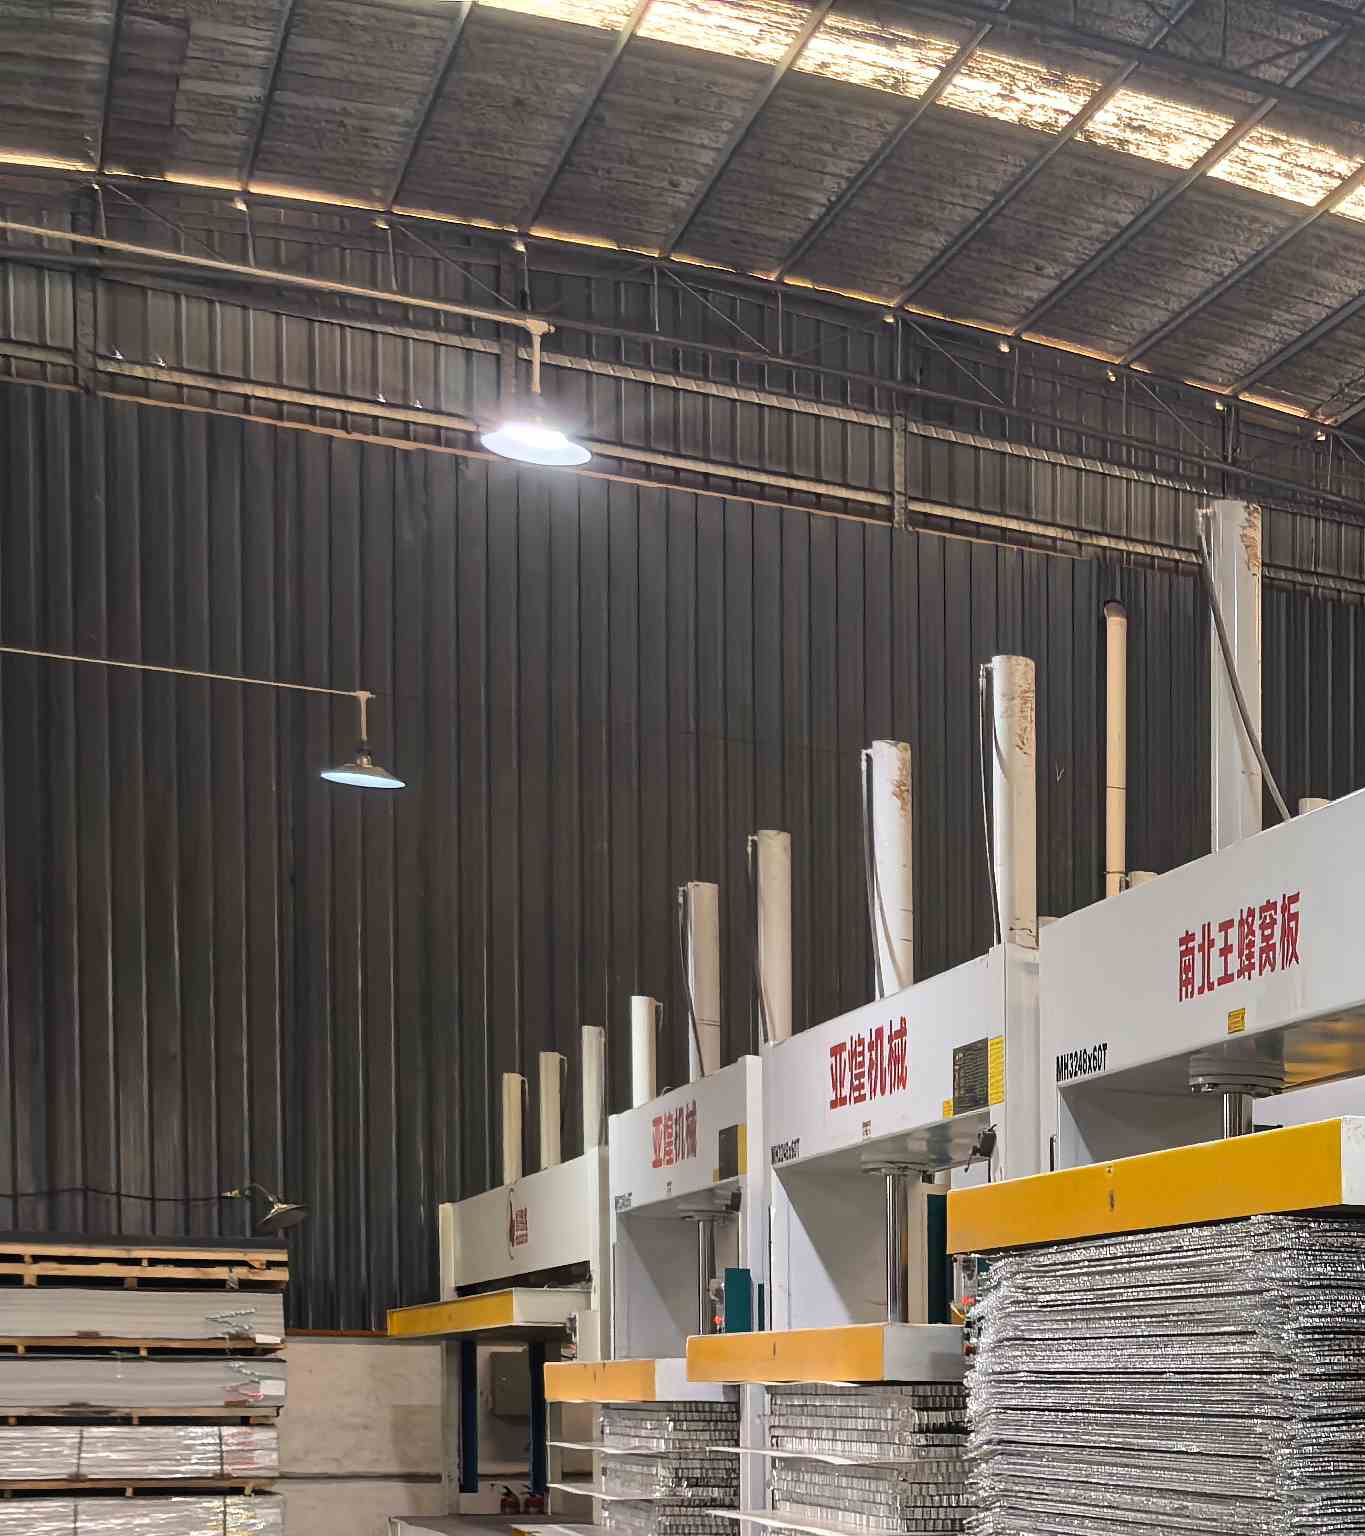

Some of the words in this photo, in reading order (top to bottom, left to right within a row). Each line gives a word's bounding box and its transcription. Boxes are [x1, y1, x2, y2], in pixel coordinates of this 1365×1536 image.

[1179, 892, 1301, 1002] 南北王蜂窝板
[830, 1016, 908, 1110] 亚煌机械
[1055, 1043, 1108, 1083] MH3248x60T
